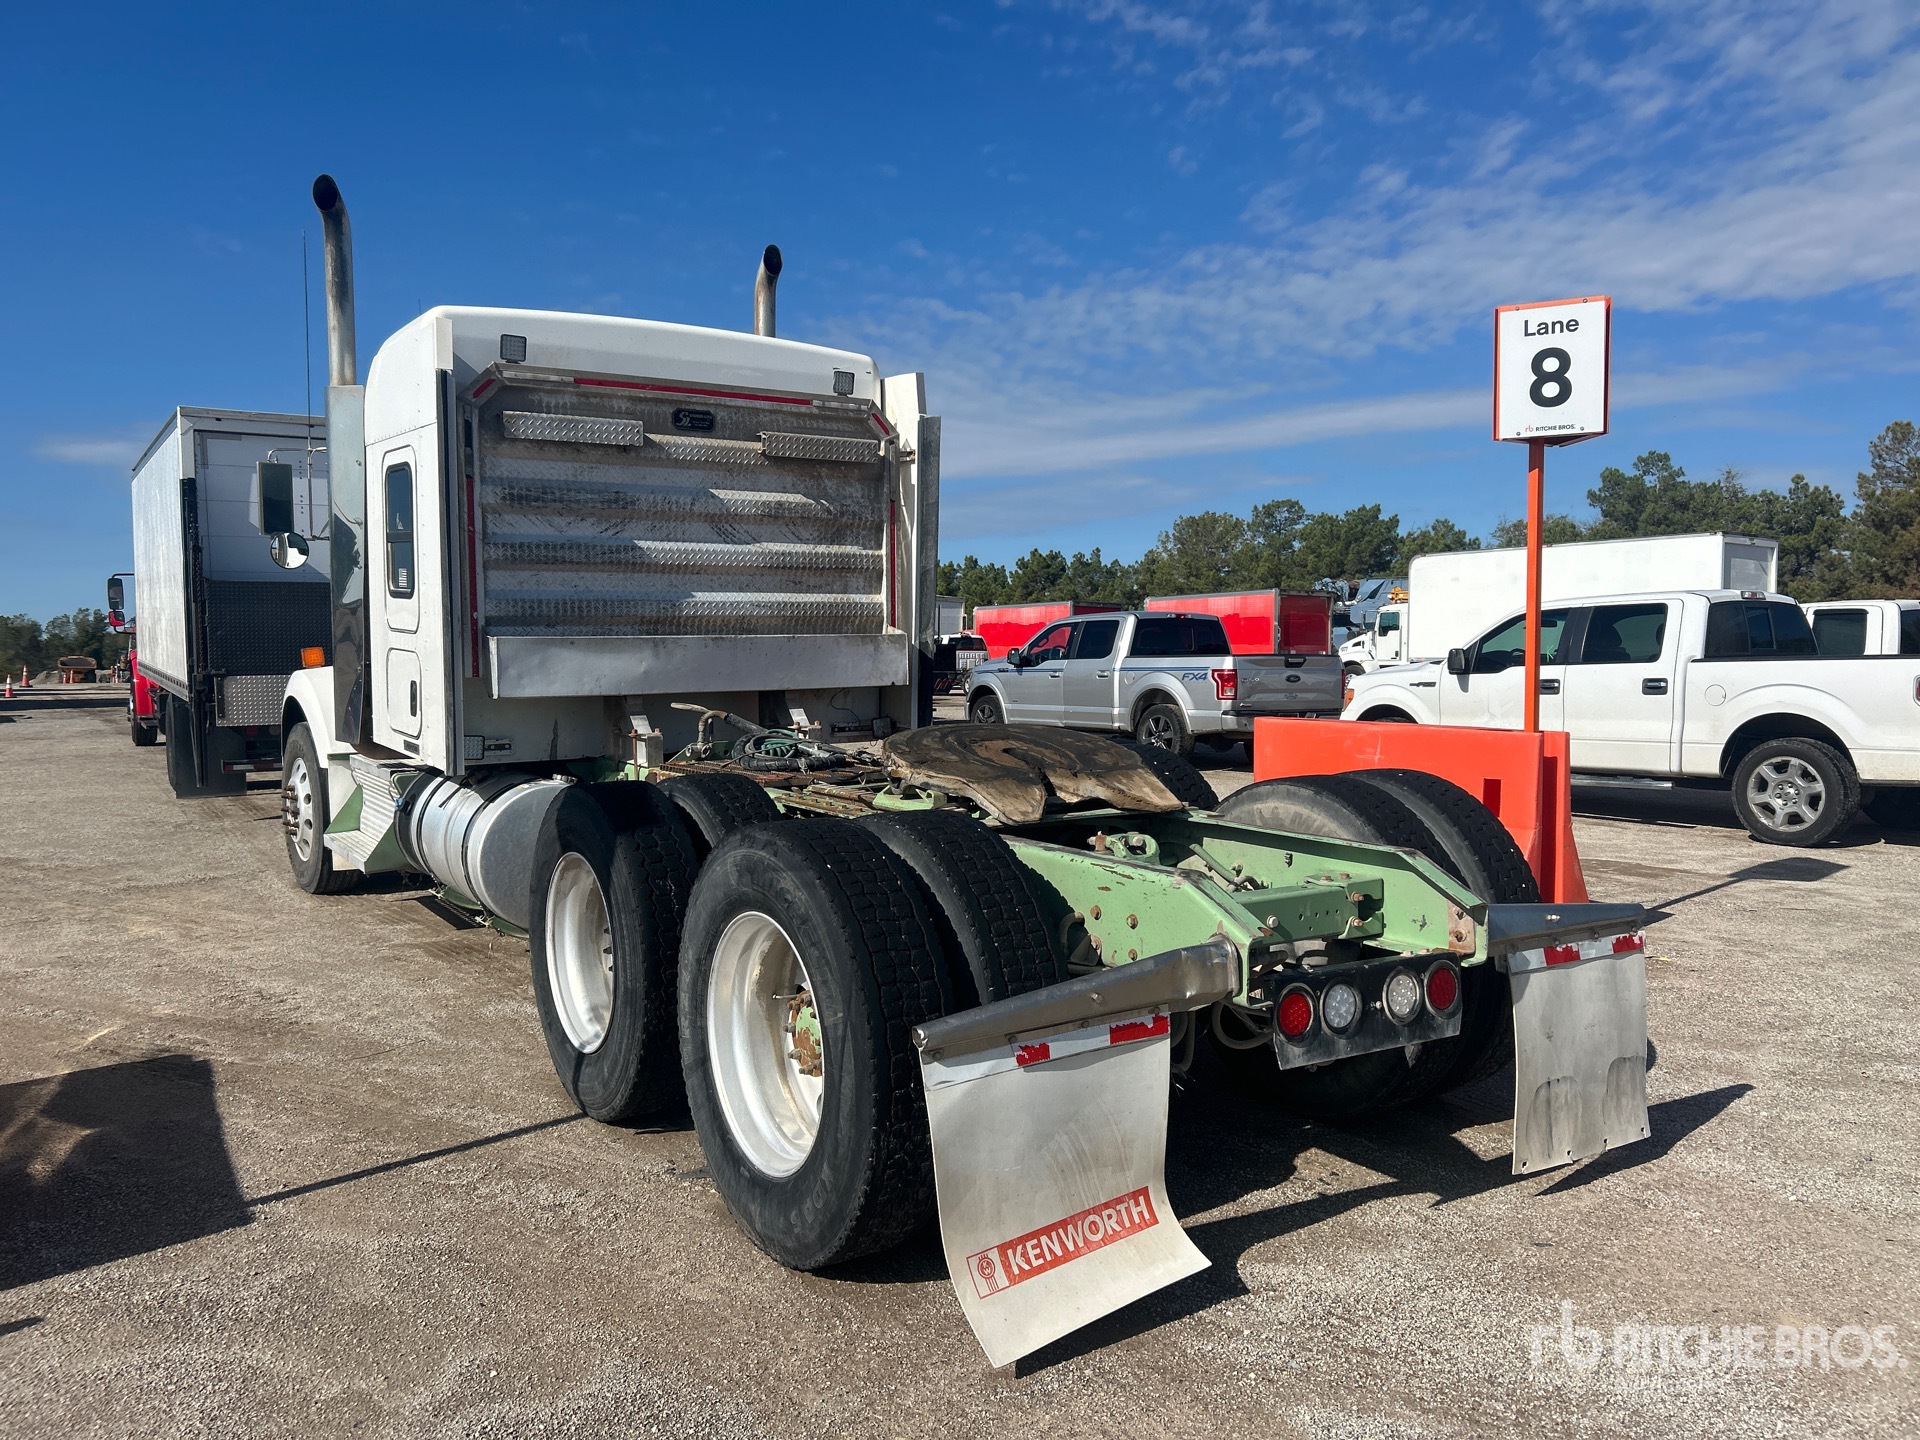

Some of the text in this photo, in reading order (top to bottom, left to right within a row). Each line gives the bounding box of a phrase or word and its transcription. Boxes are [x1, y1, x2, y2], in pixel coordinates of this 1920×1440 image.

[1524, 318, 1579, 337] Lane
[1529, 347, 1572, 408] 8
[1181, 672, 1208, 681] FX4
[1006, 1195, 1151, 1276] KENWORTH
